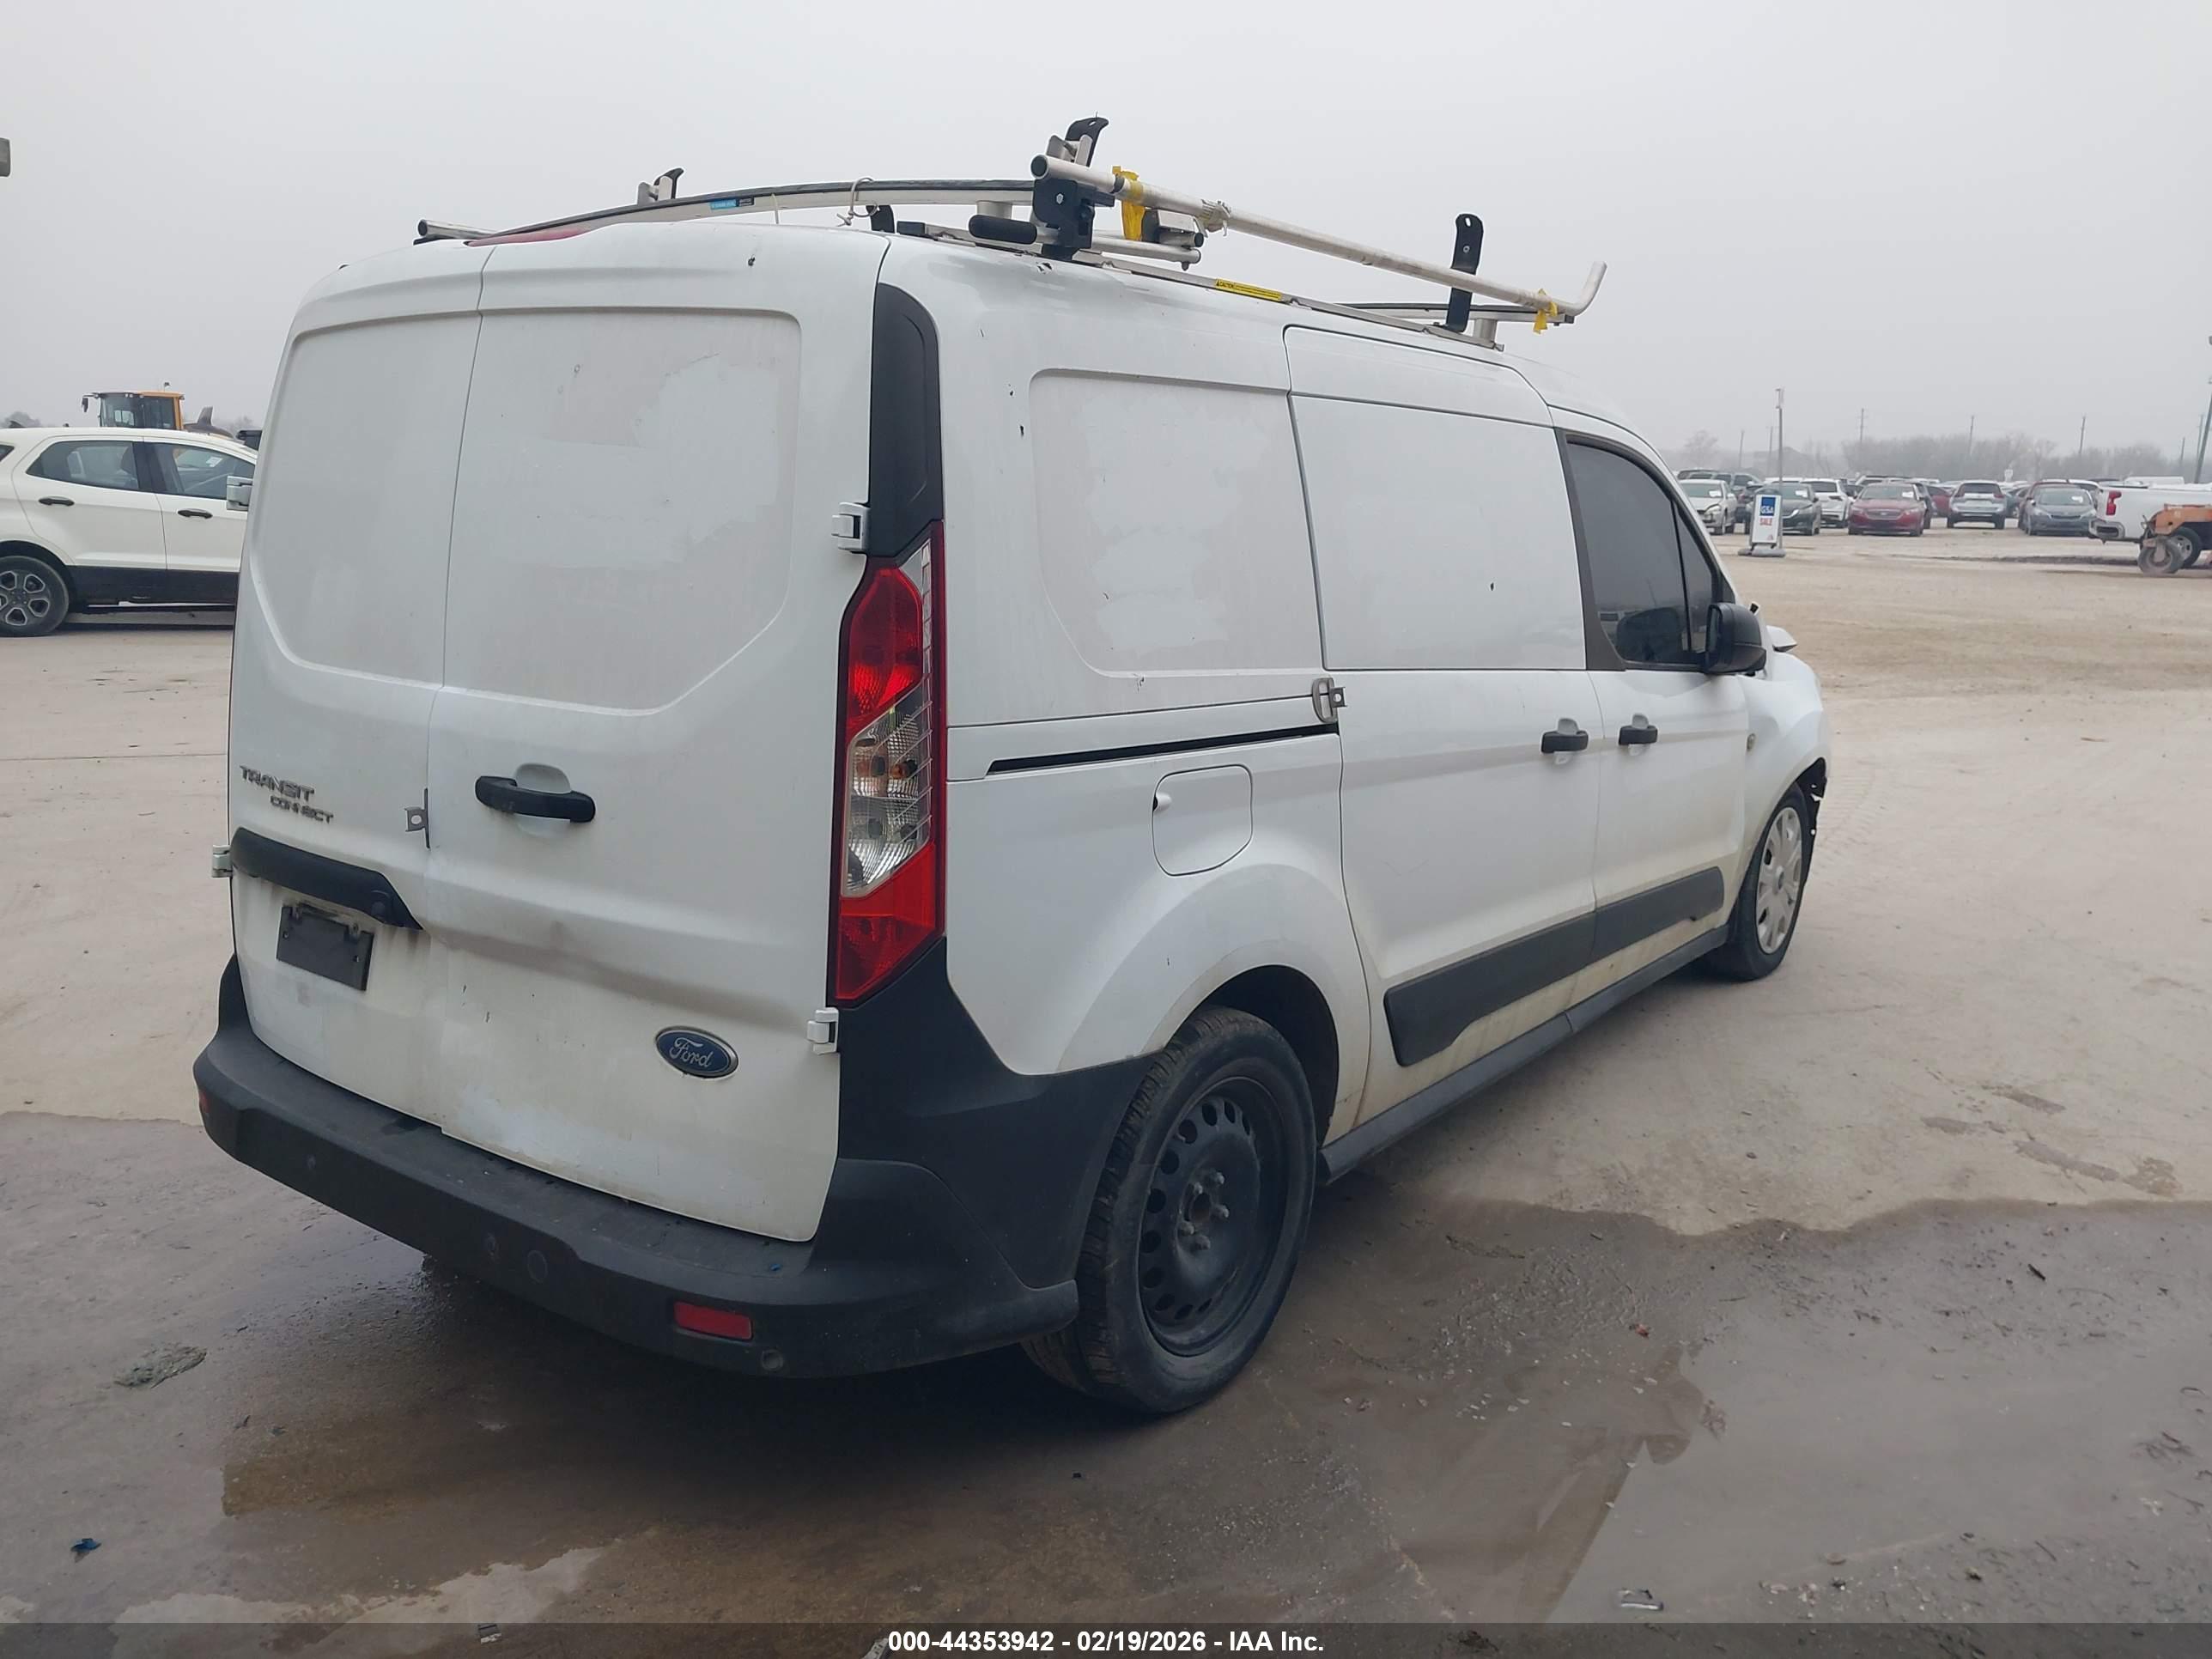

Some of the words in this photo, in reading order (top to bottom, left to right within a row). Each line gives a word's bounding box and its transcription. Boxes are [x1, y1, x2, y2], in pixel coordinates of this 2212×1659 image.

[240, 765, 314, 803] TRANSIT
[270, 795, 334, 823] CONNECT
[669, 1036, 714, 1068] Ford
